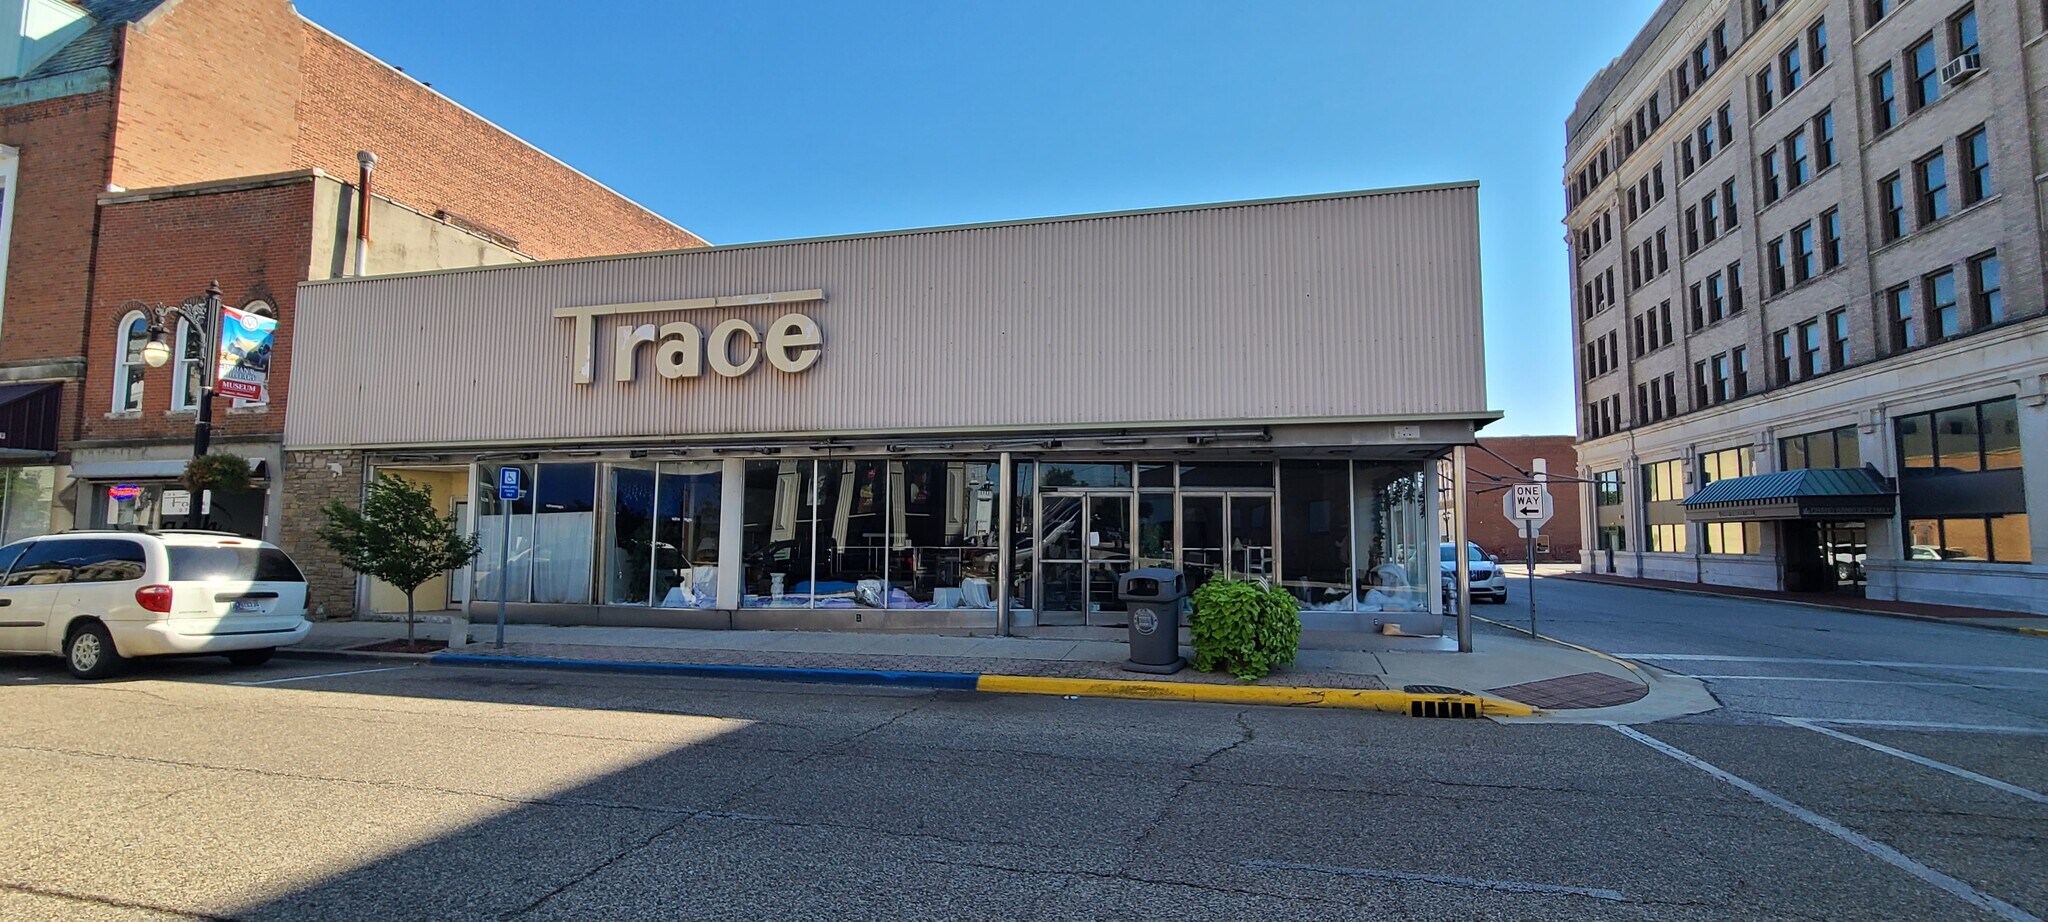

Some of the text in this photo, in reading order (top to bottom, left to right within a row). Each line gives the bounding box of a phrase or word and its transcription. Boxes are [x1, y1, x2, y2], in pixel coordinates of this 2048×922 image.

[553, 288, 826, 385] Trace
[222, 381, 256, 392] MUSEUM
[1517, 486, 1539, 495] ONE
[1517, 496, 1539, 505] WAY
